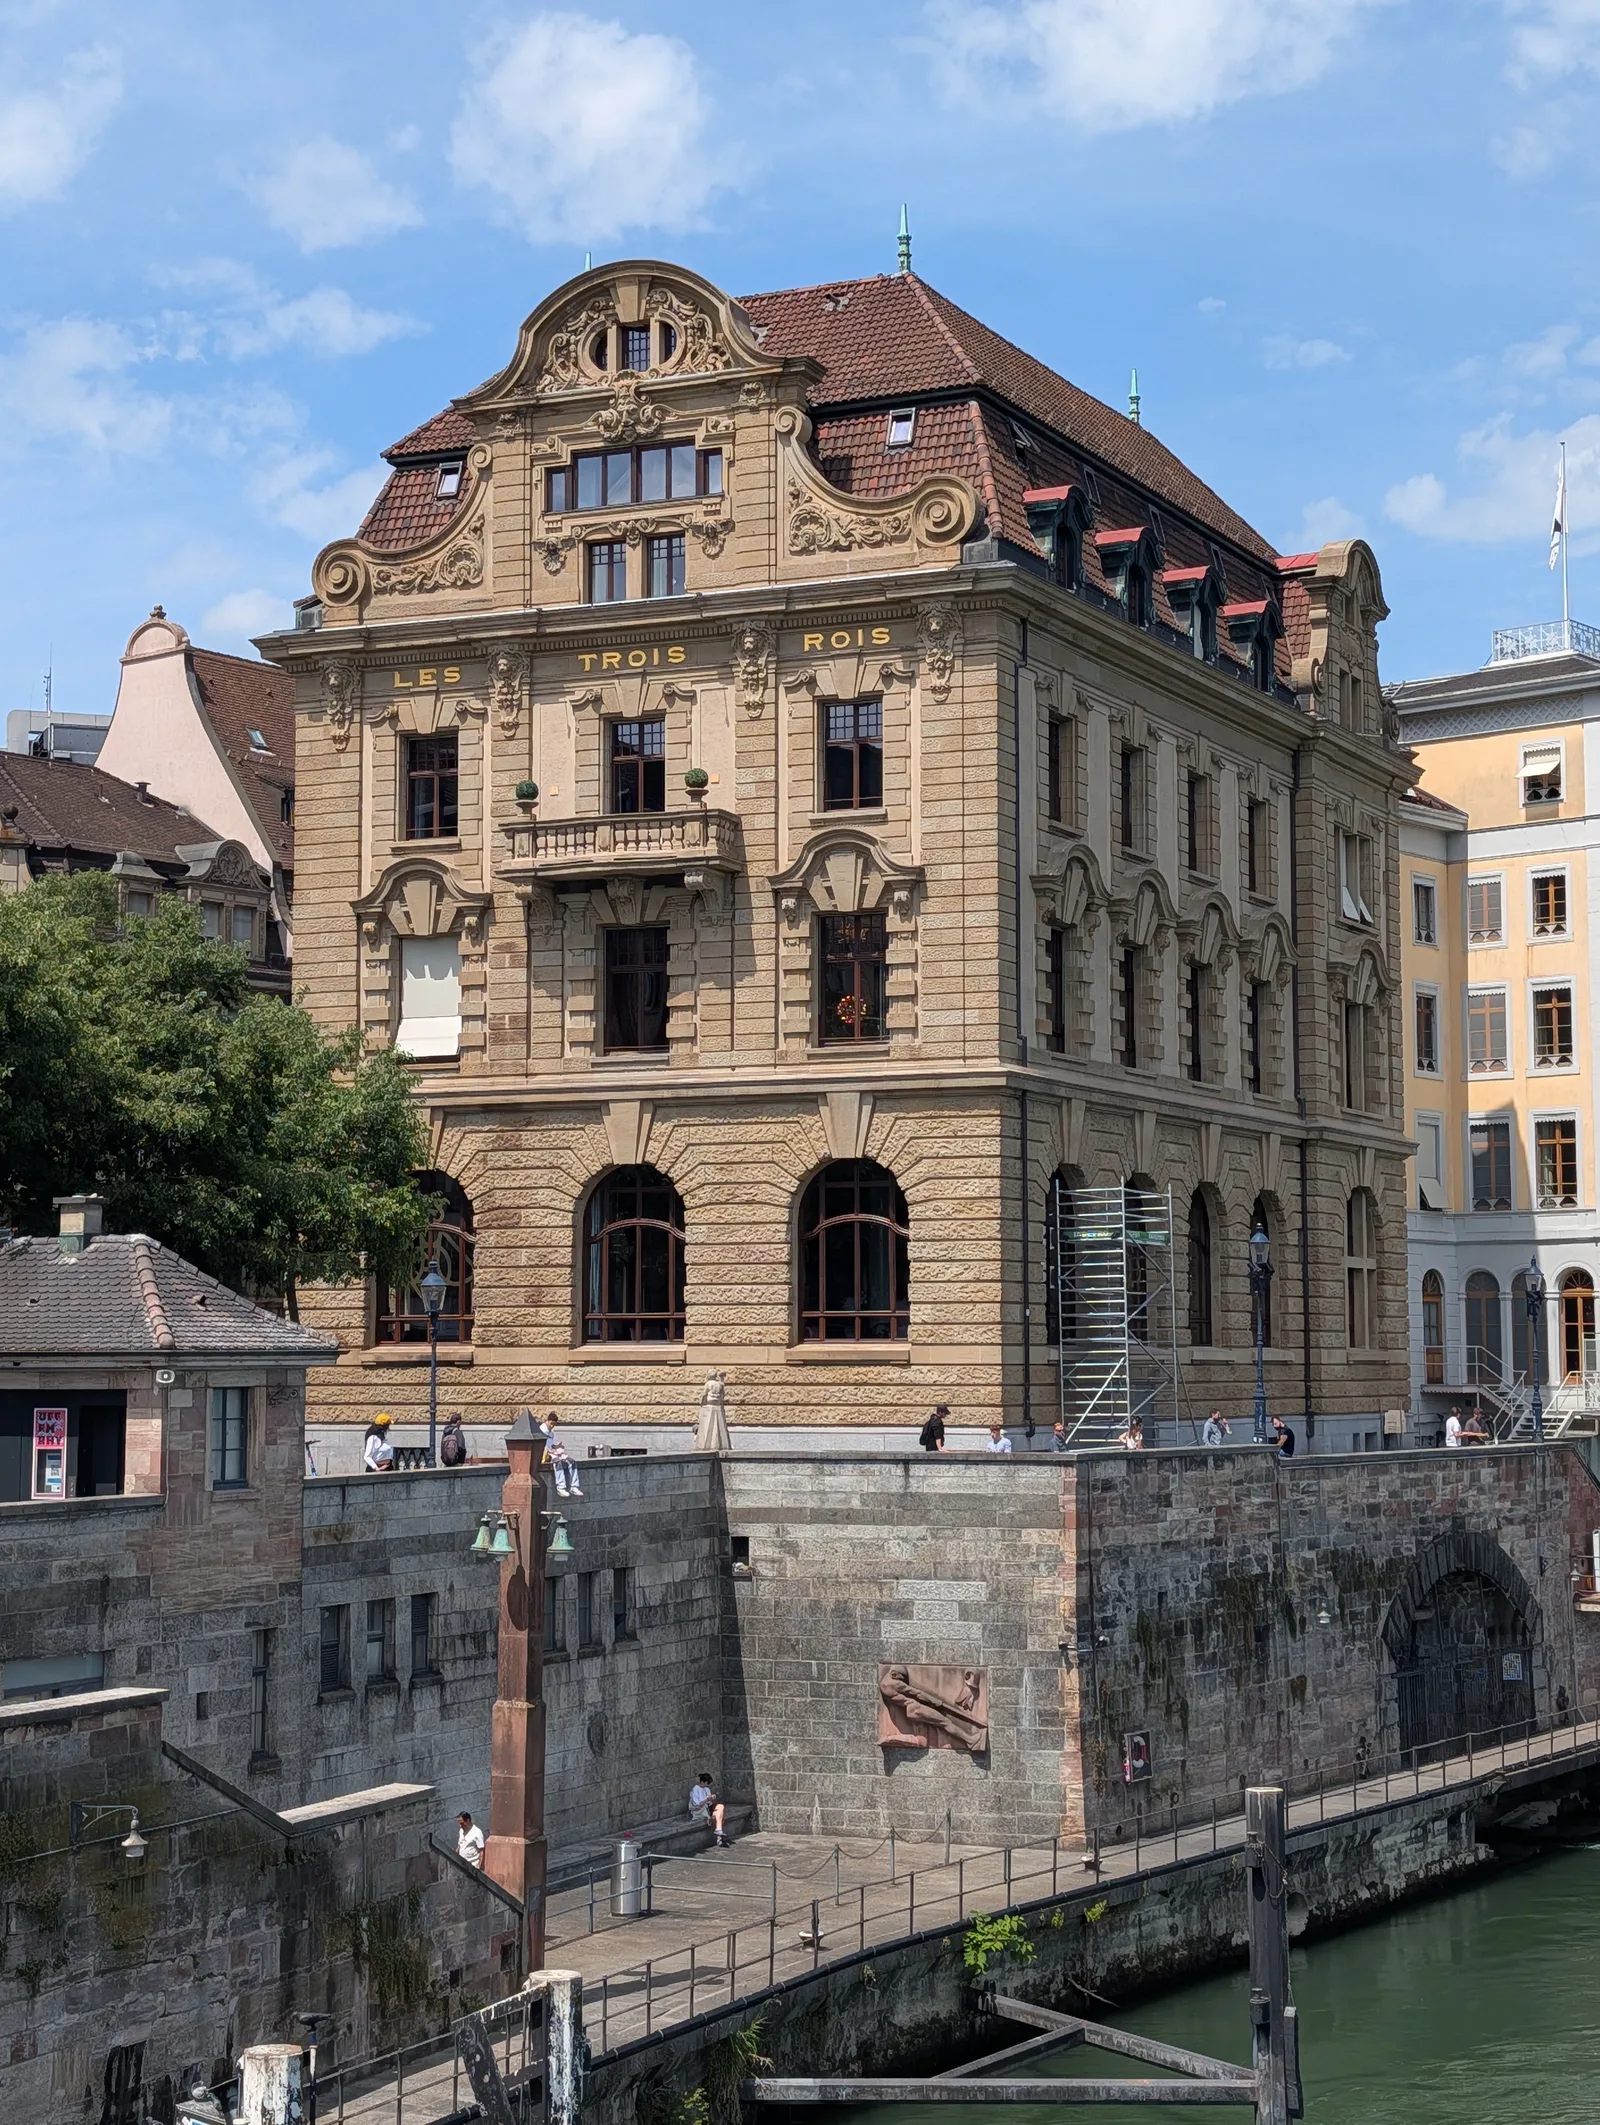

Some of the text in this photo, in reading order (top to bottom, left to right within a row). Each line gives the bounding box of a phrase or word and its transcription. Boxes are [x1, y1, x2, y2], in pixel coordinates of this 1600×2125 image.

[393, 627, 891, 688] LES TROIS ROIS
